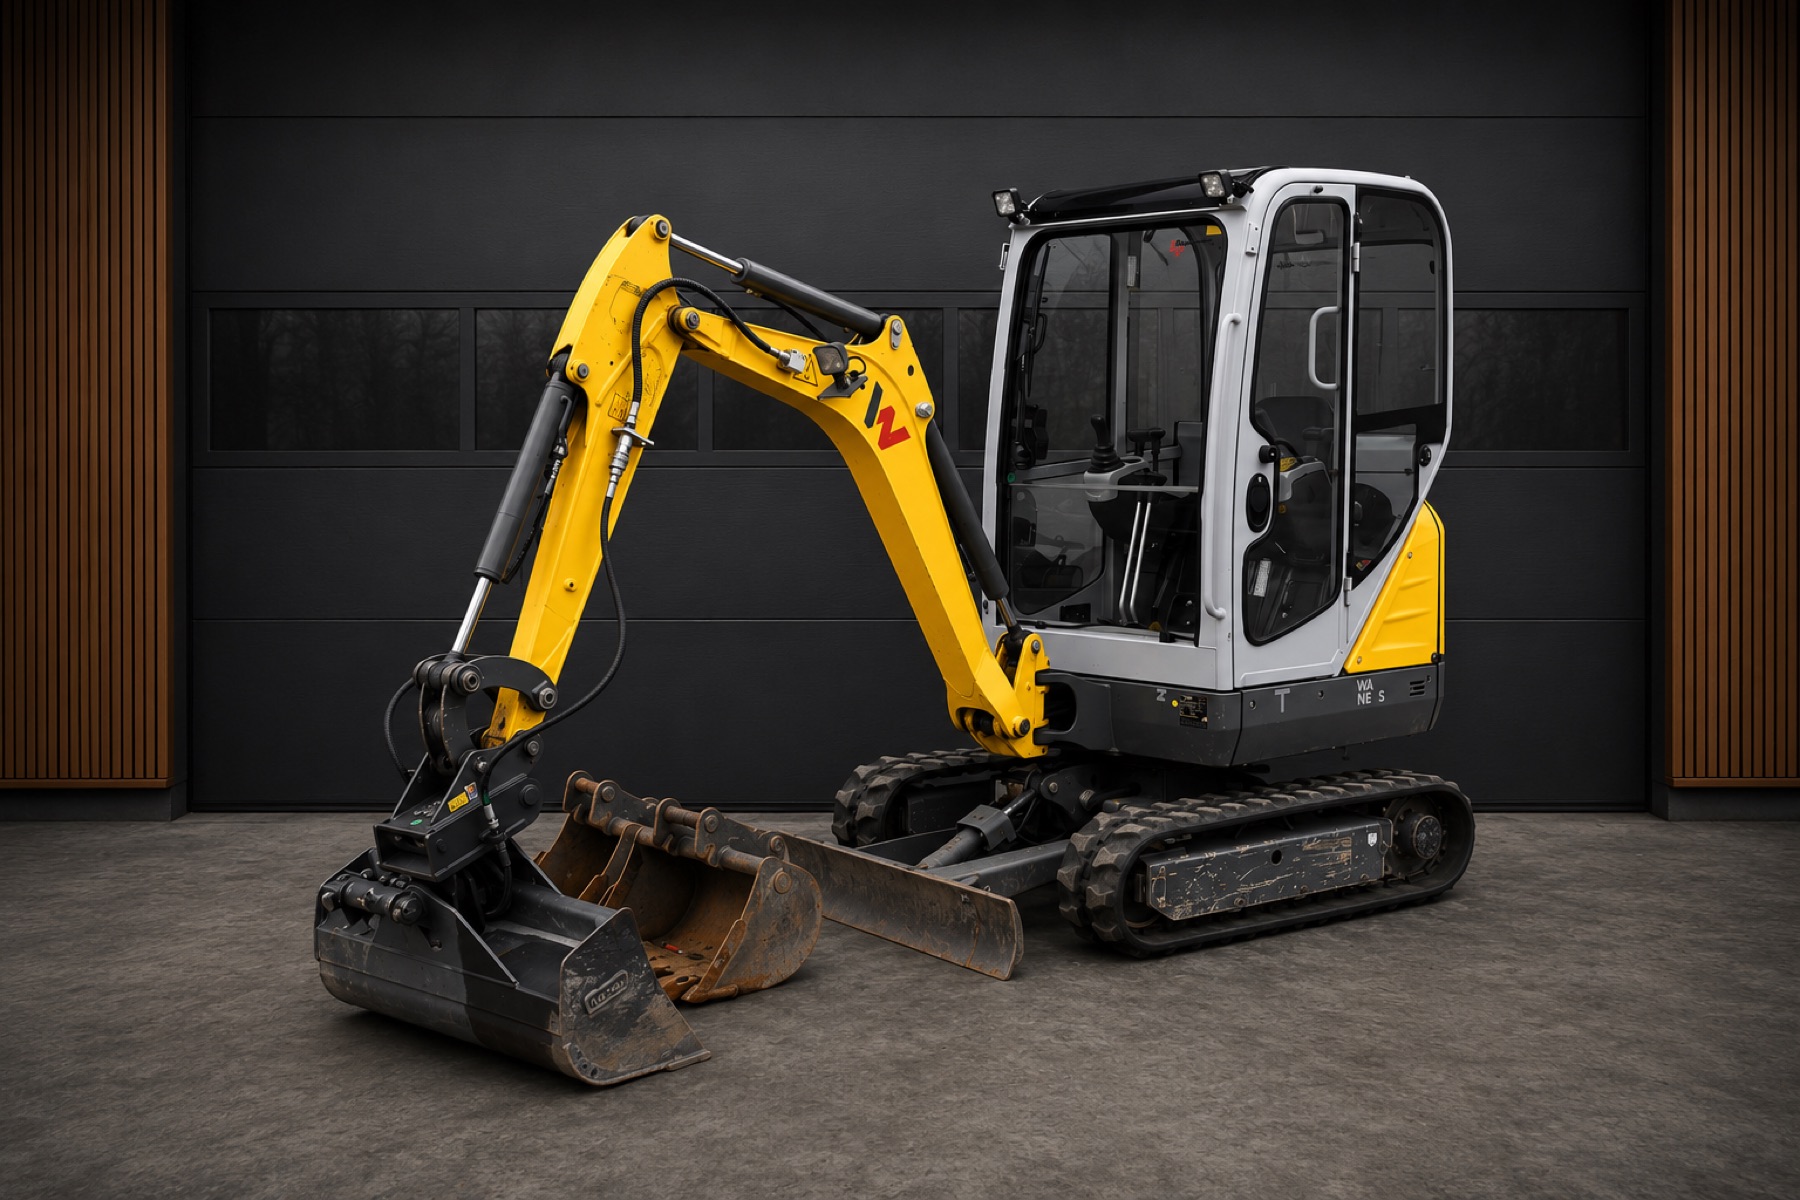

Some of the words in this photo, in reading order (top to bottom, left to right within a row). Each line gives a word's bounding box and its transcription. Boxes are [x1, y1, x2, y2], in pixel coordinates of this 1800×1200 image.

[1356, 678, 1374, 691] WA
[1357, 691, 1372, 706] NE
[1378, 689, 1385, 703] S
